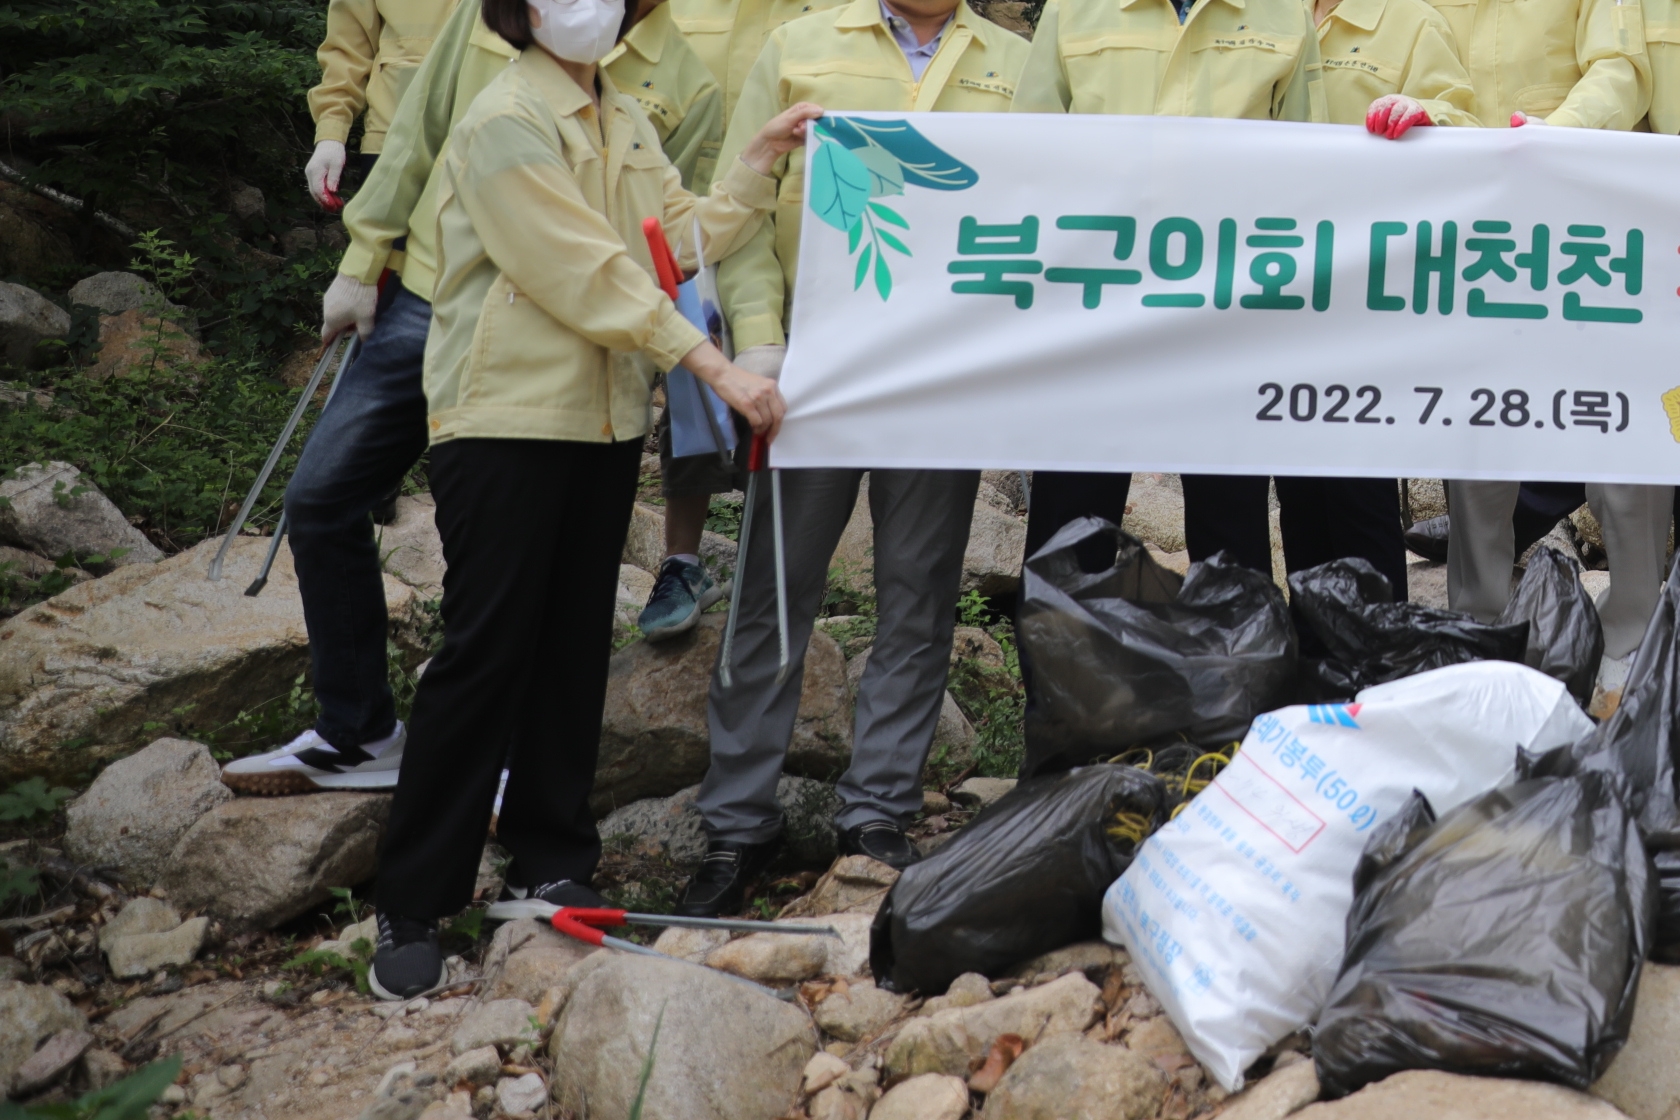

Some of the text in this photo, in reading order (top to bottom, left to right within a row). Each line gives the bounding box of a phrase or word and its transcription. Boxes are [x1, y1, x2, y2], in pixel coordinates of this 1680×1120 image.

[947, 215, 1335, 312] 북구의회
[1366, 220, 1644, 324] 대천천
[1255, 382, 1630, 434] 2022. 7. 28.(목)
